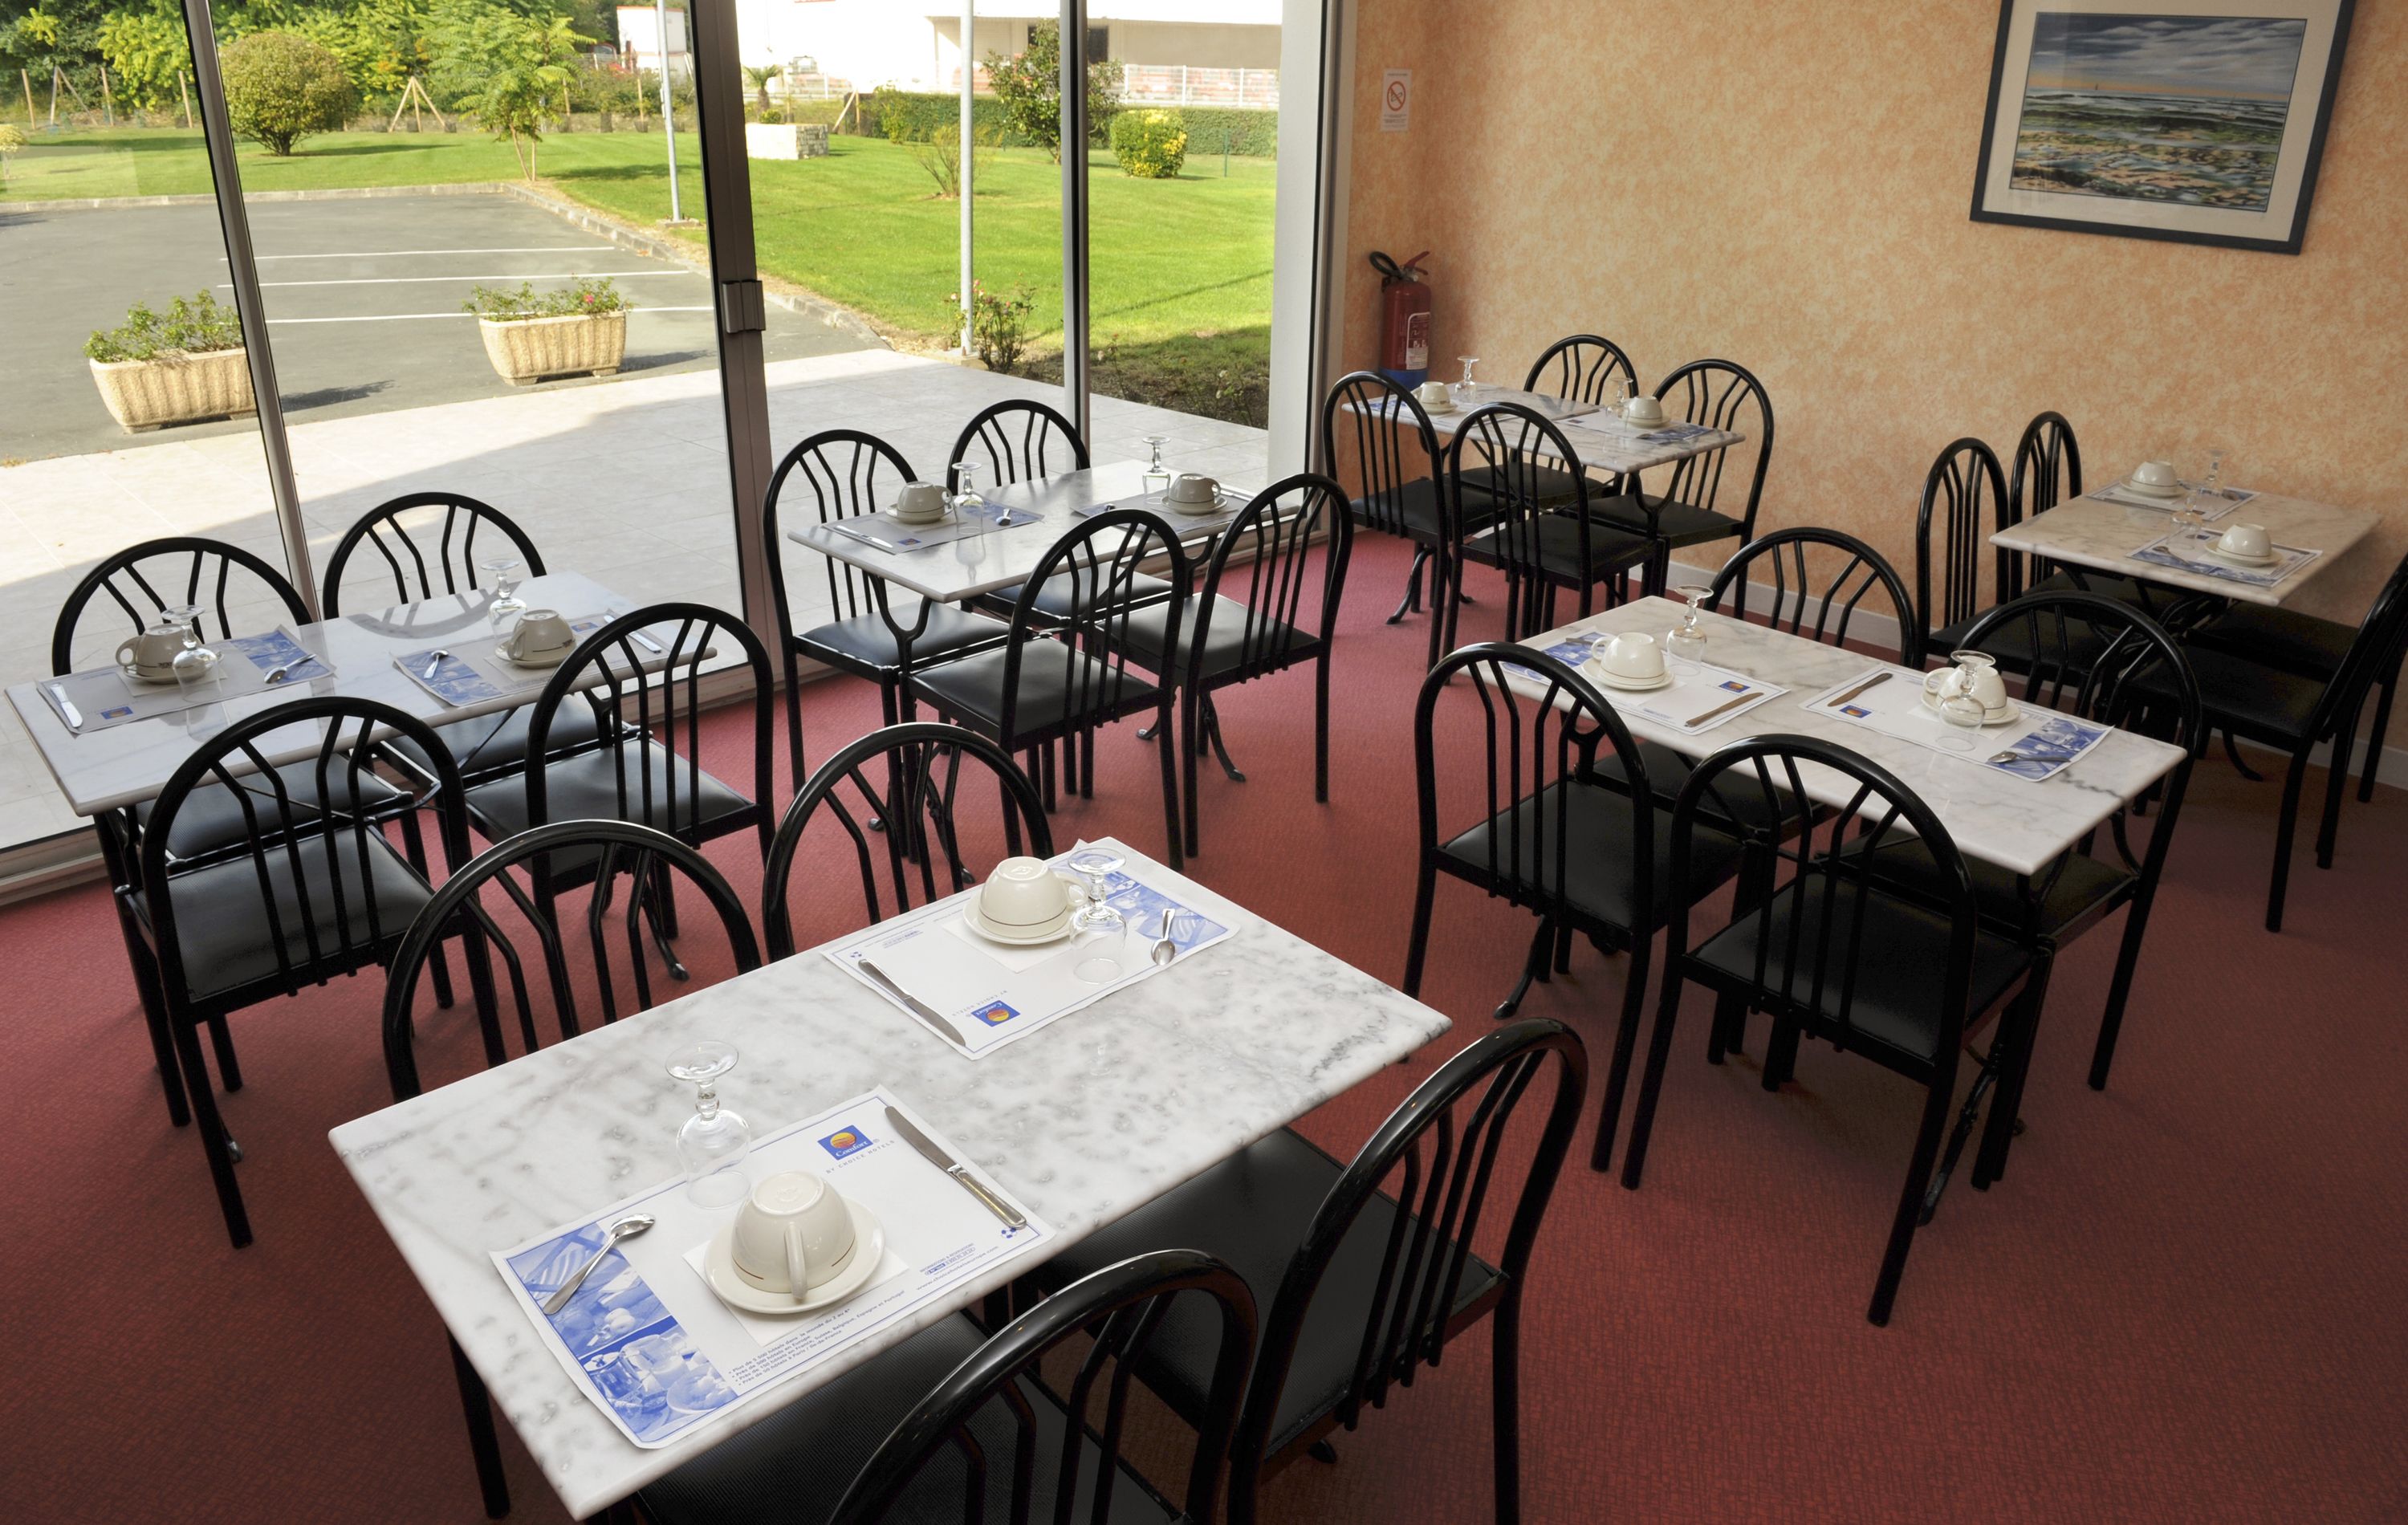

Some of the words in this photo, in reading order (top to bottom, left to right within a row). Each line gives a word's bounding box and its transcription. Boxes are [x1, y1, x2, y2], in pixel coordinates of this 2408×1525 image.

[825, 1166, 835, 1174] BY
[838, 1153, 866, 1169] CHOICE
[868, 1139, 896, 1155] HOTELS
[836, 1141, 868, 1157] Comfort
[884, 1289, 905, 1303] Portugal
[785, 1336, 798, 1345] dans
[806, 1322, 824, 1334] monde
[791, 1335, 810, 1348] Europe
[792, 1348, 806, 1358] Paris
